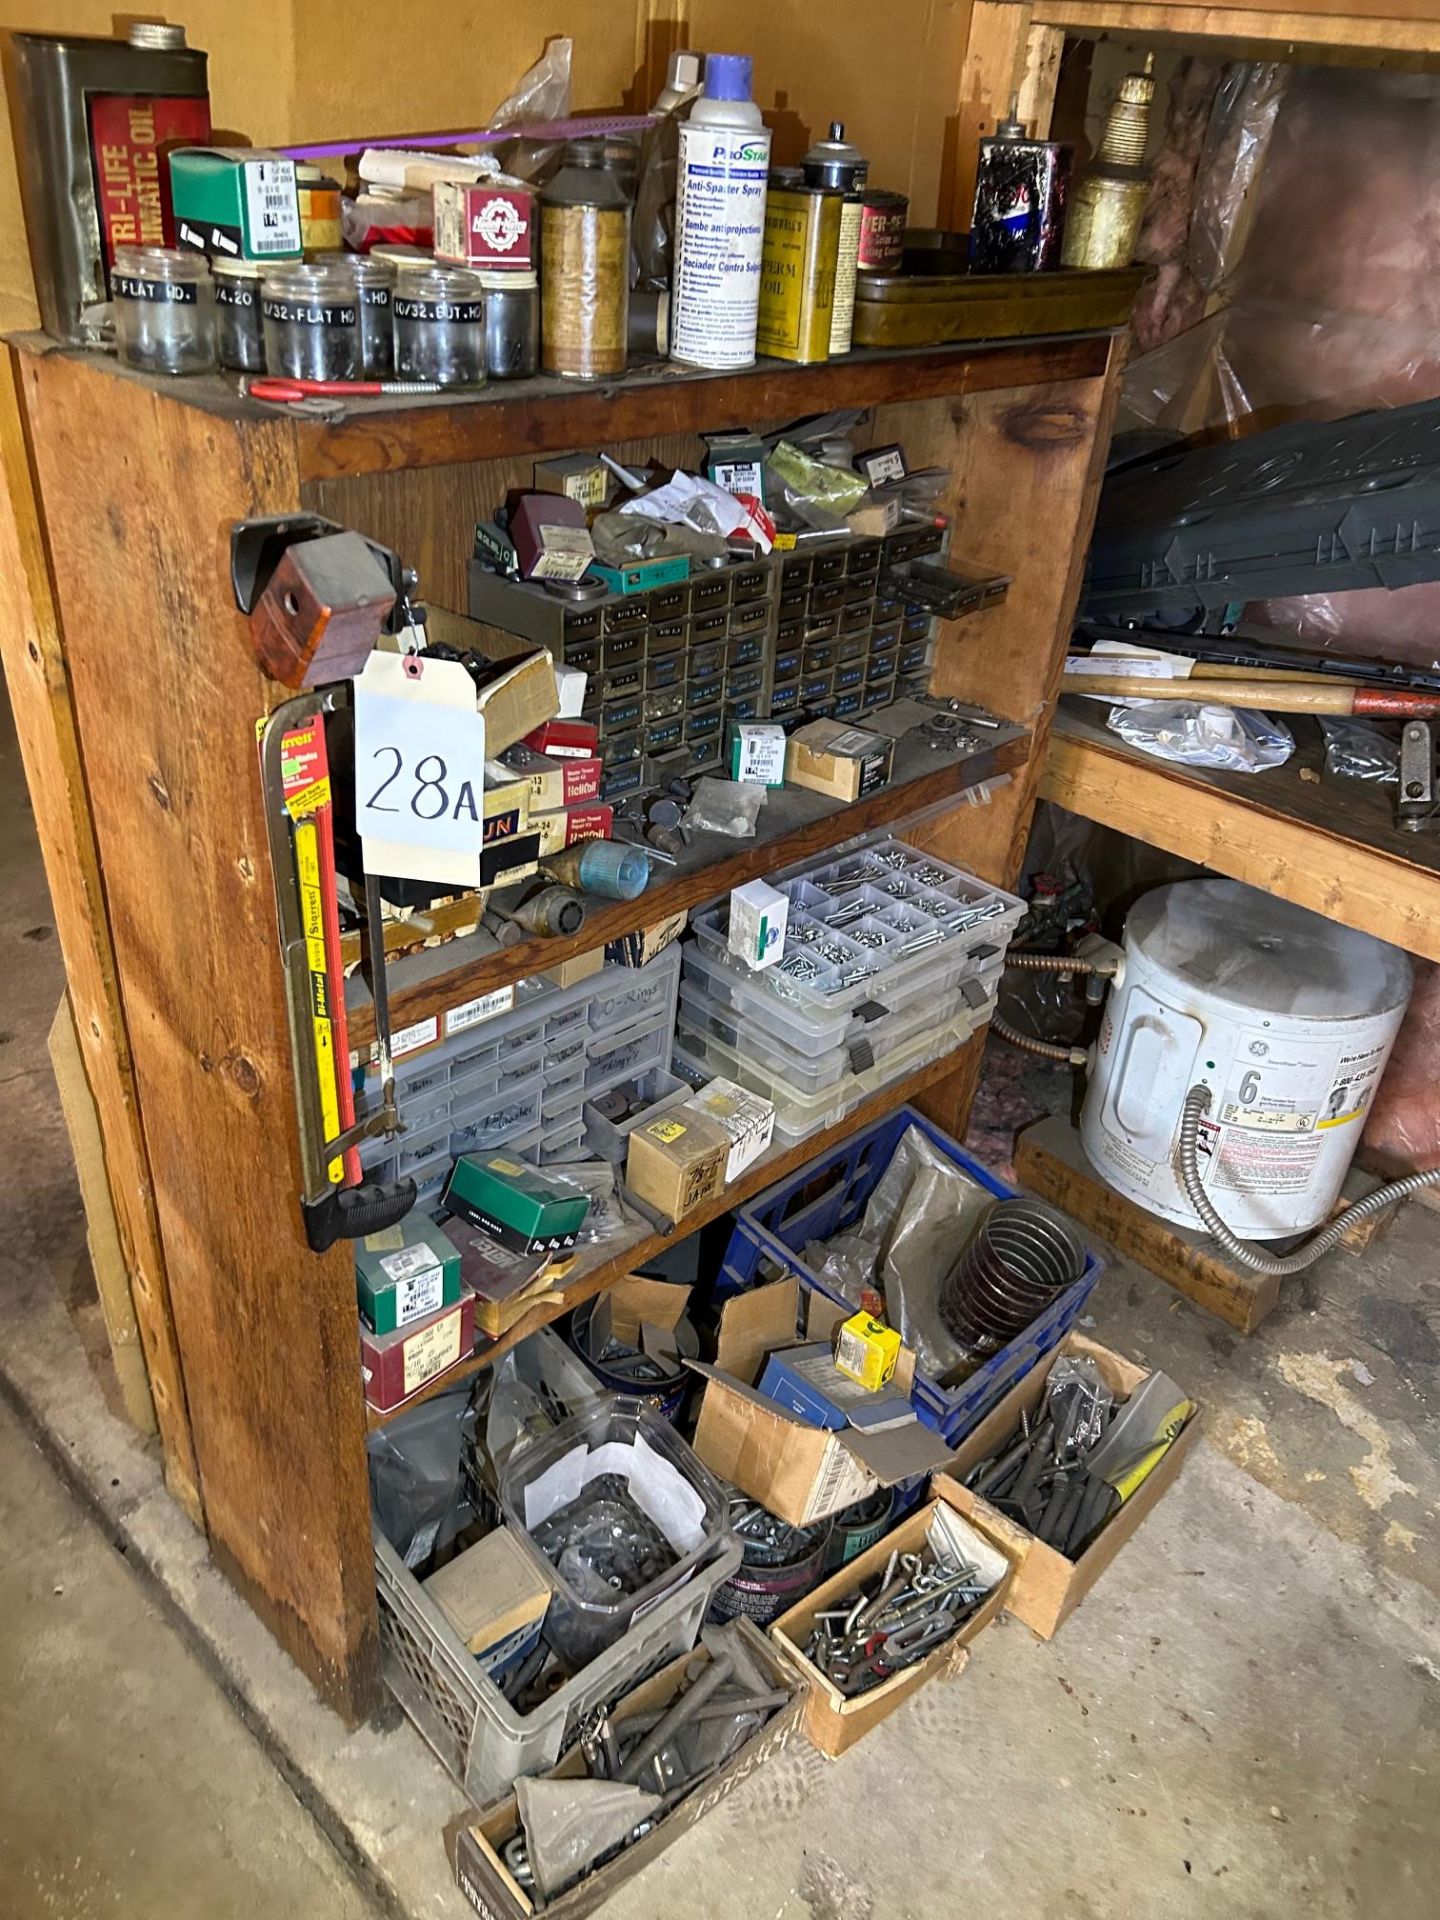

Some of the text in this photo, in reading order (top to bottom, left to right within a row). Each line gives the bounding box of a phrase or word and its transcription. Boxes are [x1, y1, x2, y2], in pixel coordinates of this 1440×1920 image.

[742, 184, 762, 197] Spray
[718, 261, 744, 273] Contra
[121, 279, 191, 301] FLAT HD.
[365, 746, 480, 822] 28A
[308, 889, 321, 935] Starrett
[1238, 1070, 1262, 1105] 6
